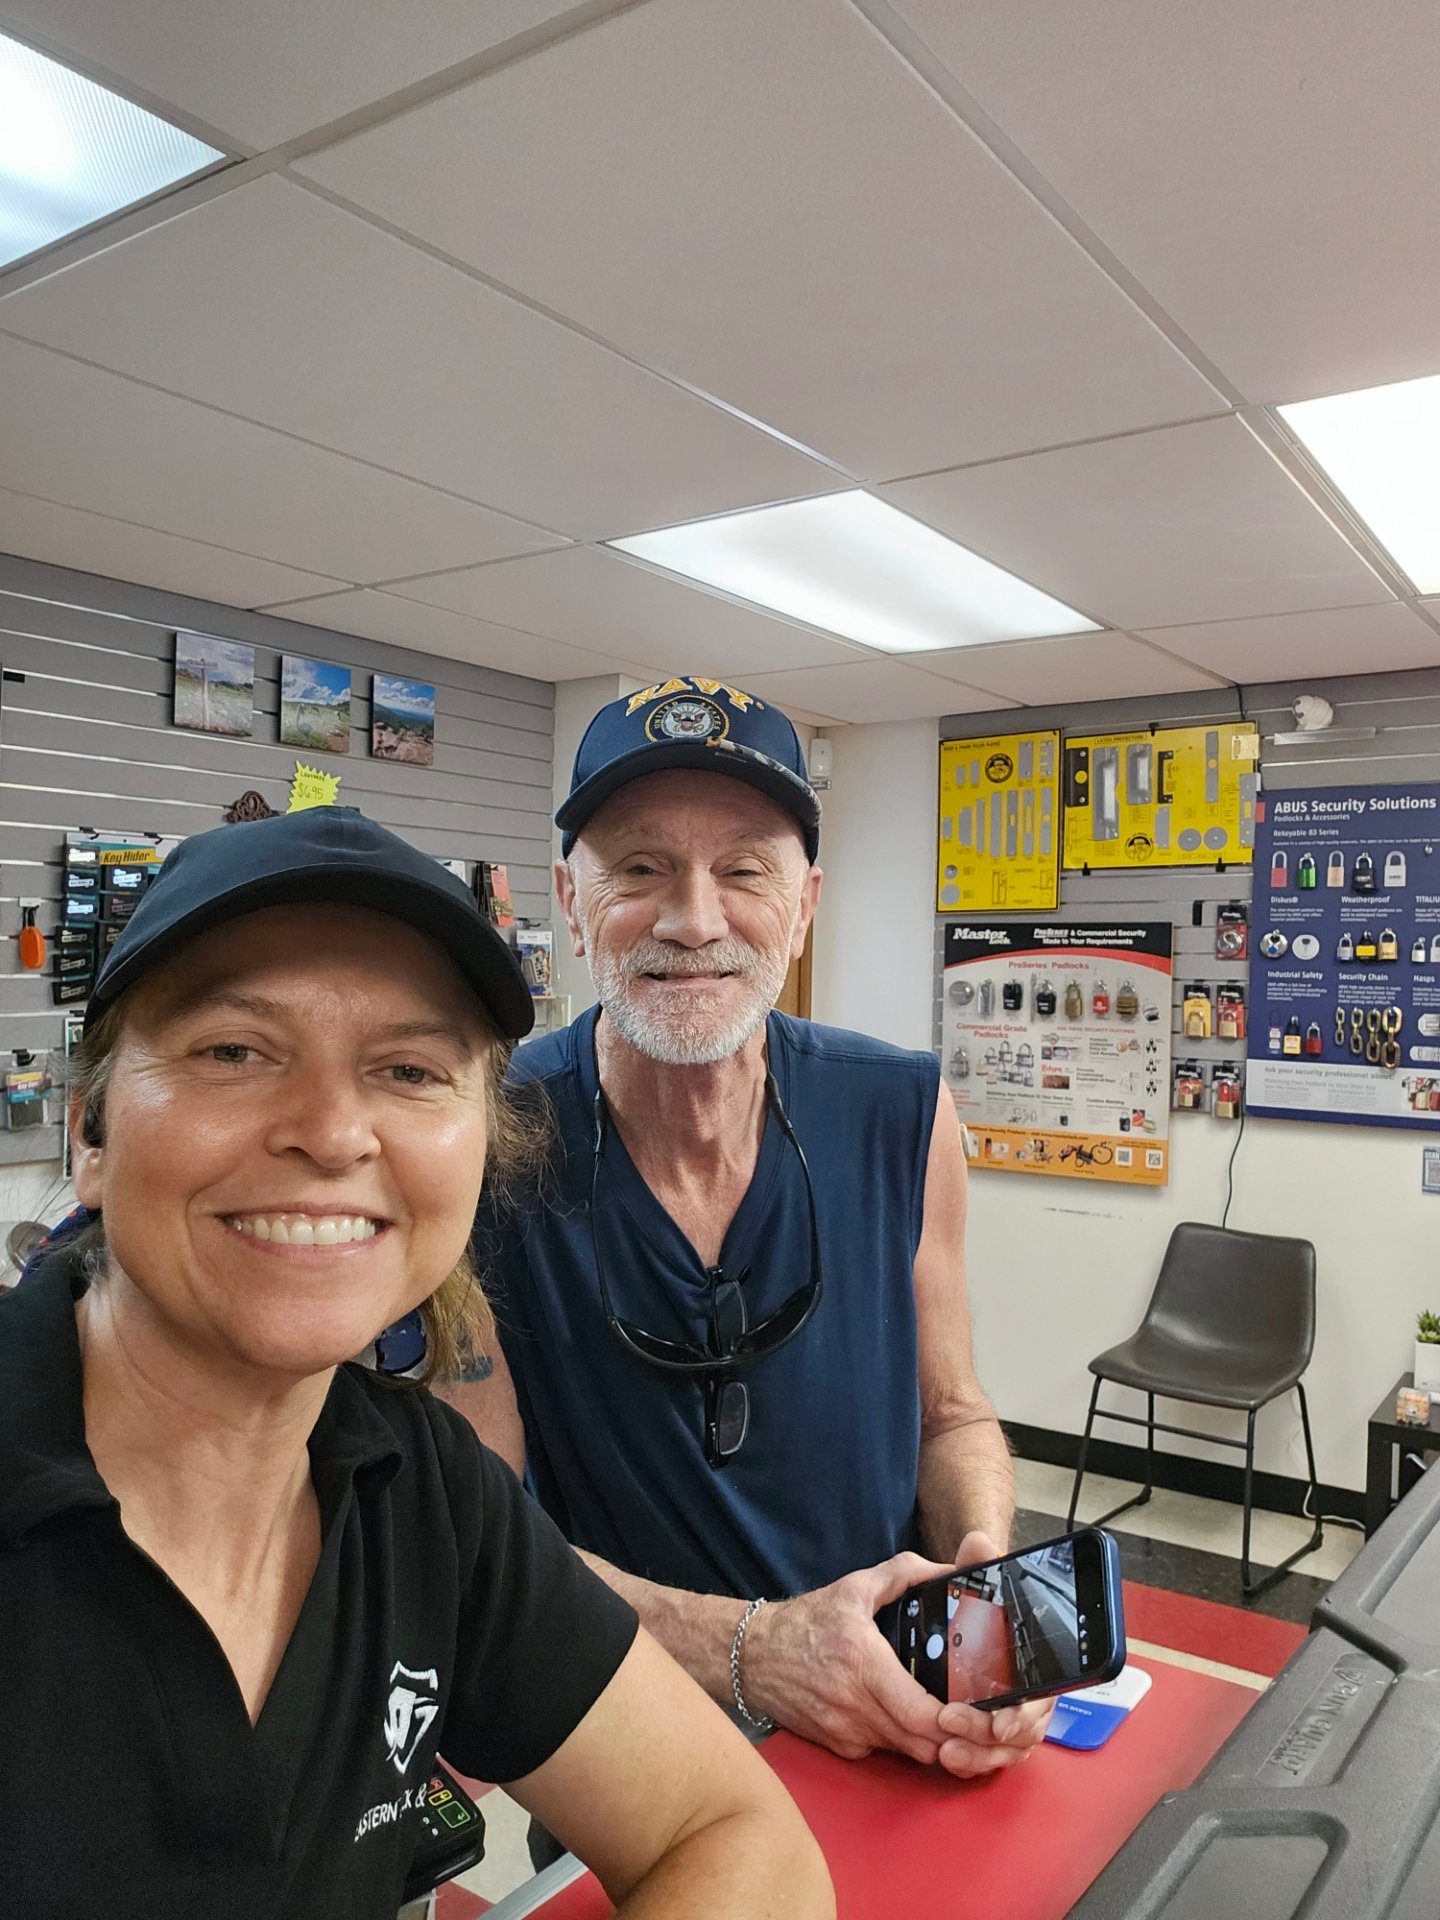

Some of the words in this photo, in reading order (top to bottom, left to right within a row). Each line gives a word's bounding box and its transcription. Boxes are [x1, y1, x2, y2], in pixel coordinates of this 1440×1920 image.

[1274, 801, 1307, 814] ABUS
[1311, 798, 1366, 814] Security
[1369, 796, 1437, 810] Solutions
[1274, 814, 1303, 822] Padlocks
[1312, 813, 1350, 821] Accessories
[1273, 829, 1307, 838] Rekeyable
[1319, 828, 1339, 836] Series
[103, 852, 122, 866] Key
[123, 850, 150, 862] Hider
[1341, 896, 1390, 905] Weatherproof
[952, 927, 1007, 940] Master
[1076, 929, 1116, 937] Commercial
[1118, 929, 1147, 938] Security
[1086, 938, 1133, 946] Requirements
[1008, 961, 1047, 969] ProSeries
[1051, 961, 1090, 970] Padlocks
[1267, 971, 1301, 979] Industrial
[1302, 971, 1323, 981] Safety
[1338, 973, 1366, 982] Security
[1368, 973, 1388, 981] Chain
[1413, 975, 1435, 984] Hasps
[956, 1022, 1002, 1031] Commercial
[1003, 1024, 1028, 1032] Grade
[974, 1030, 1009, 1039] Padlocks
[1278, 1067, 1294, 1075] your
[1295, 1068, 1323, 1077] security
[1324, 1070, 1368, 1079] professional
[1319, 1684, 1359, 1716] GUN
[1280, 1716, 1332, 1776] GUARD
[415, 1782, 428, 1808] &
